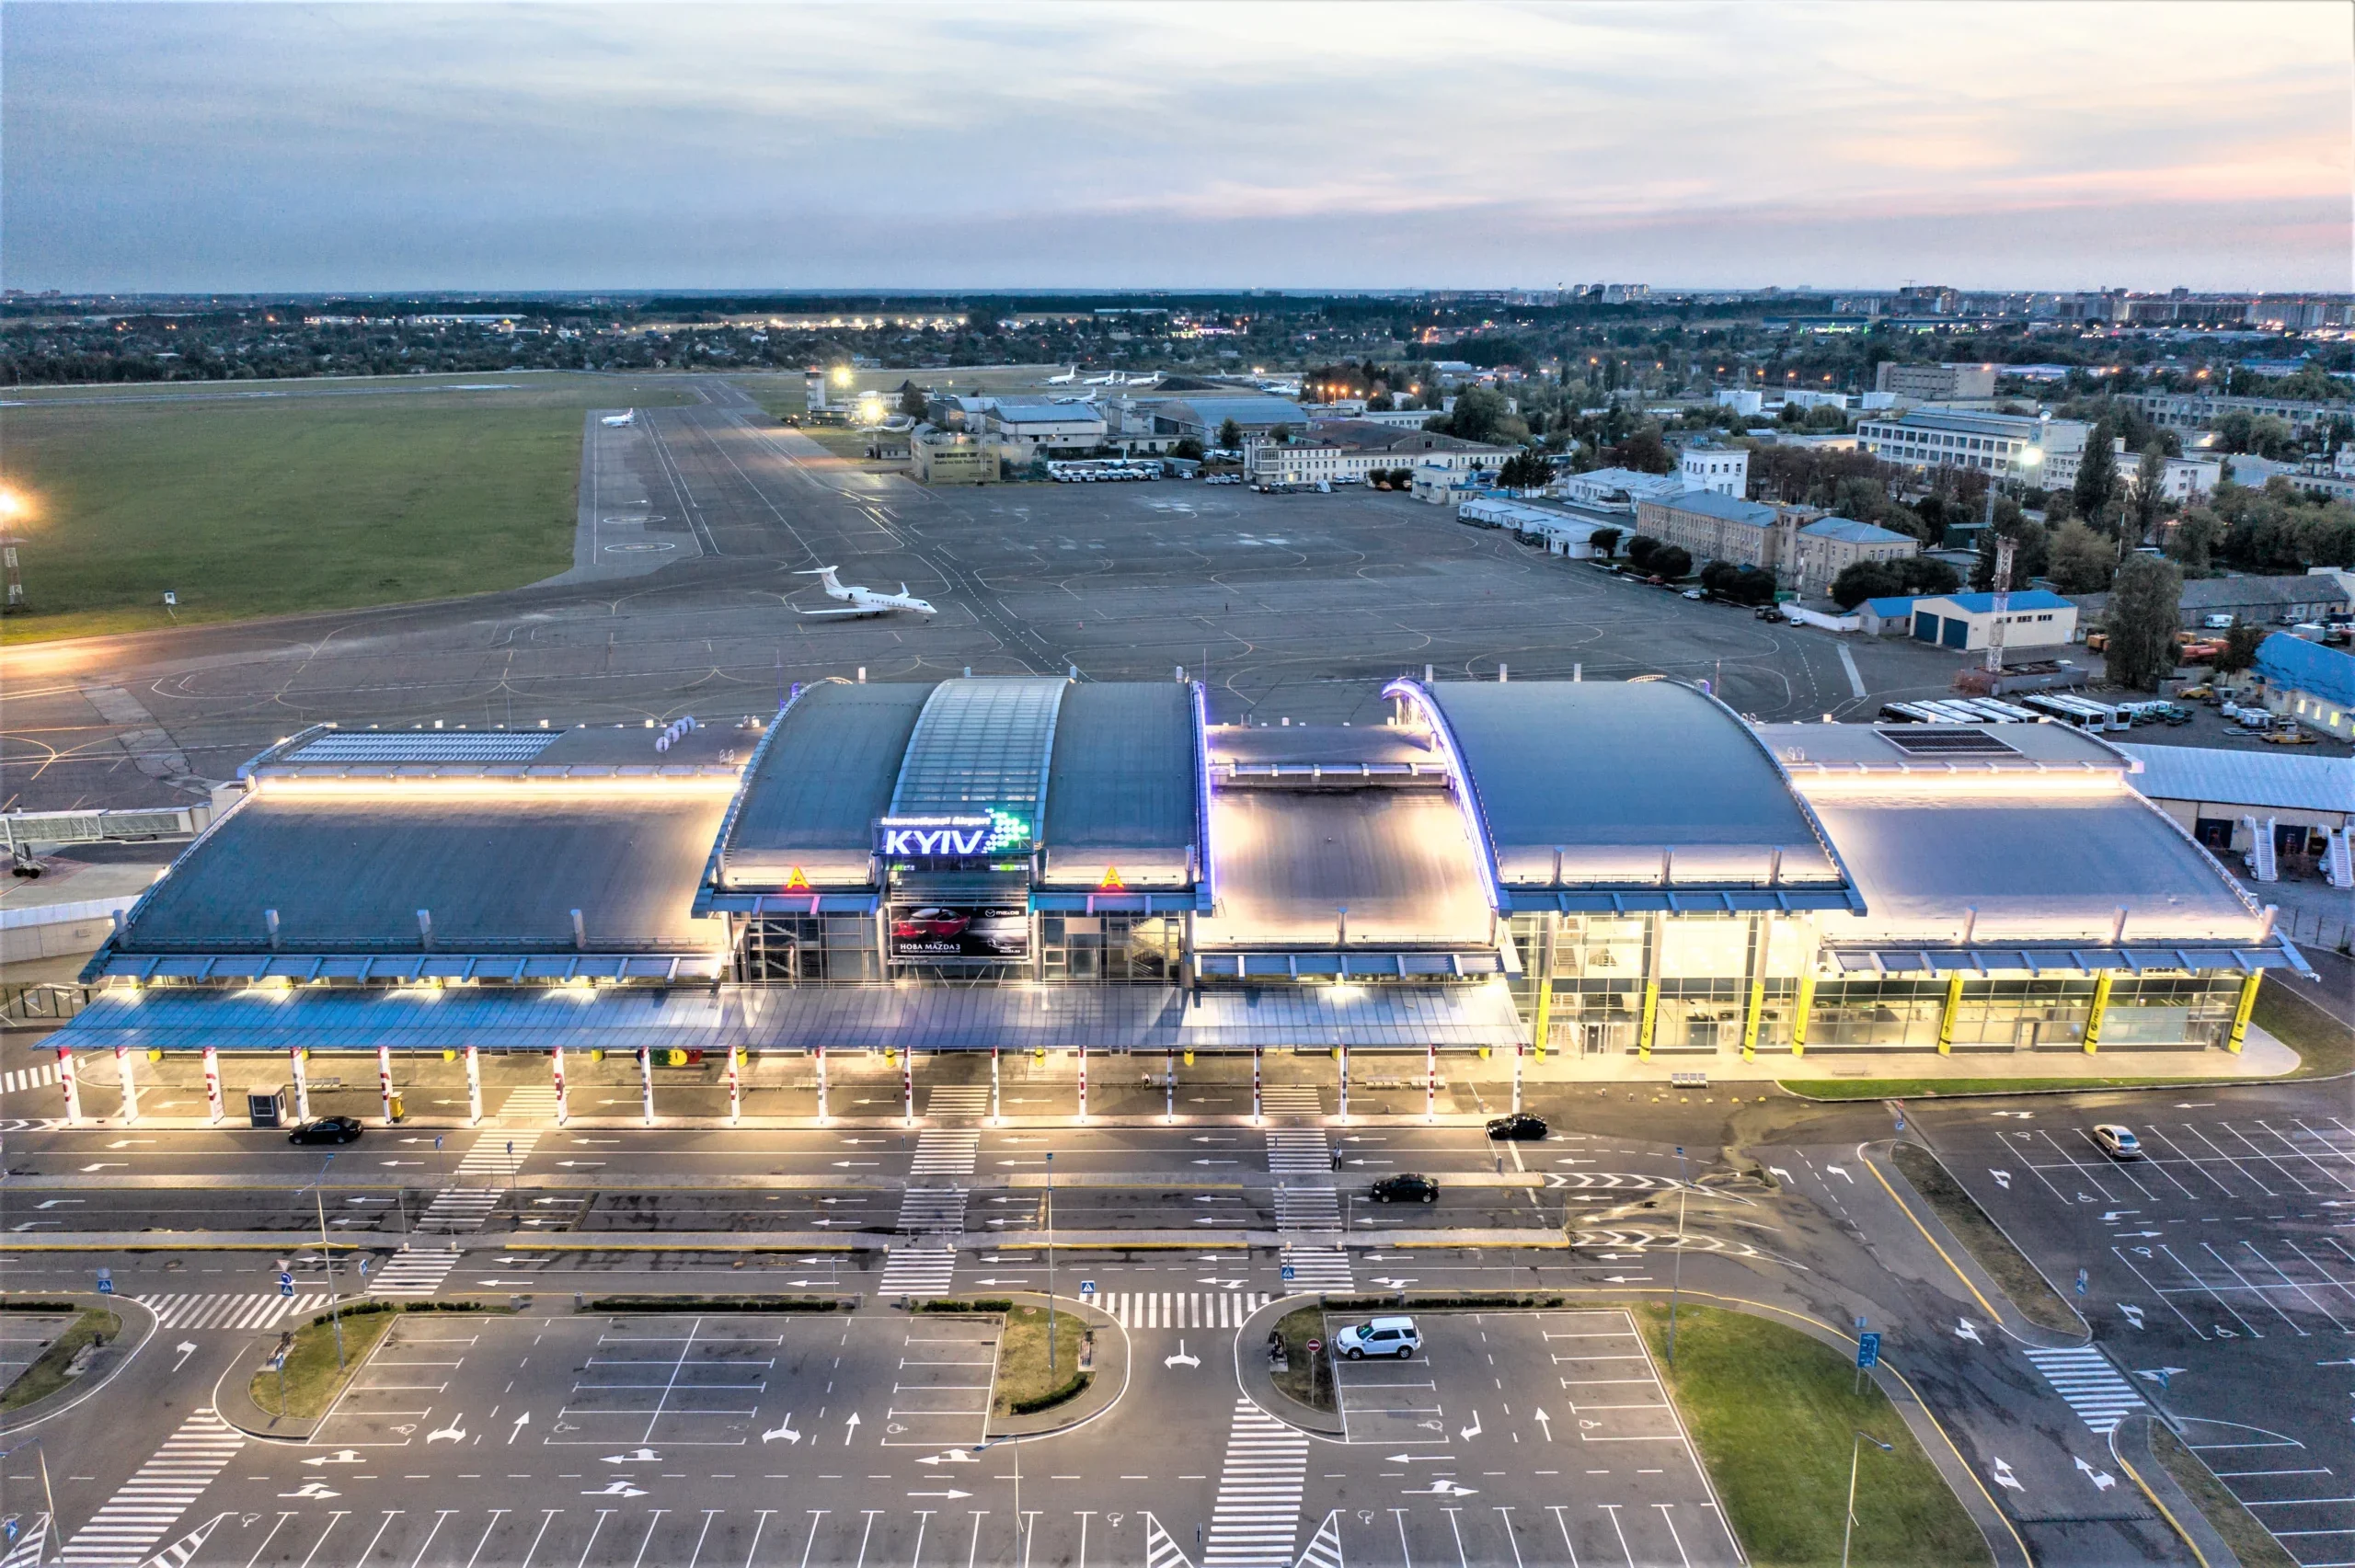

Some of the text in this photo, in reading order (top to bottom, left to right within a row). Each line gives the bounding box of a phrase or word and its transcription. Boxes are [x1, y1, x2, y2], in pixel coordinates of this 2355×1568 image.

[881, 817, 991, 826] International Airport
[886, 830, 984, 854] KYIV
[787, 866, 810, 889] A
[1101, 866, 1125, 889] A
